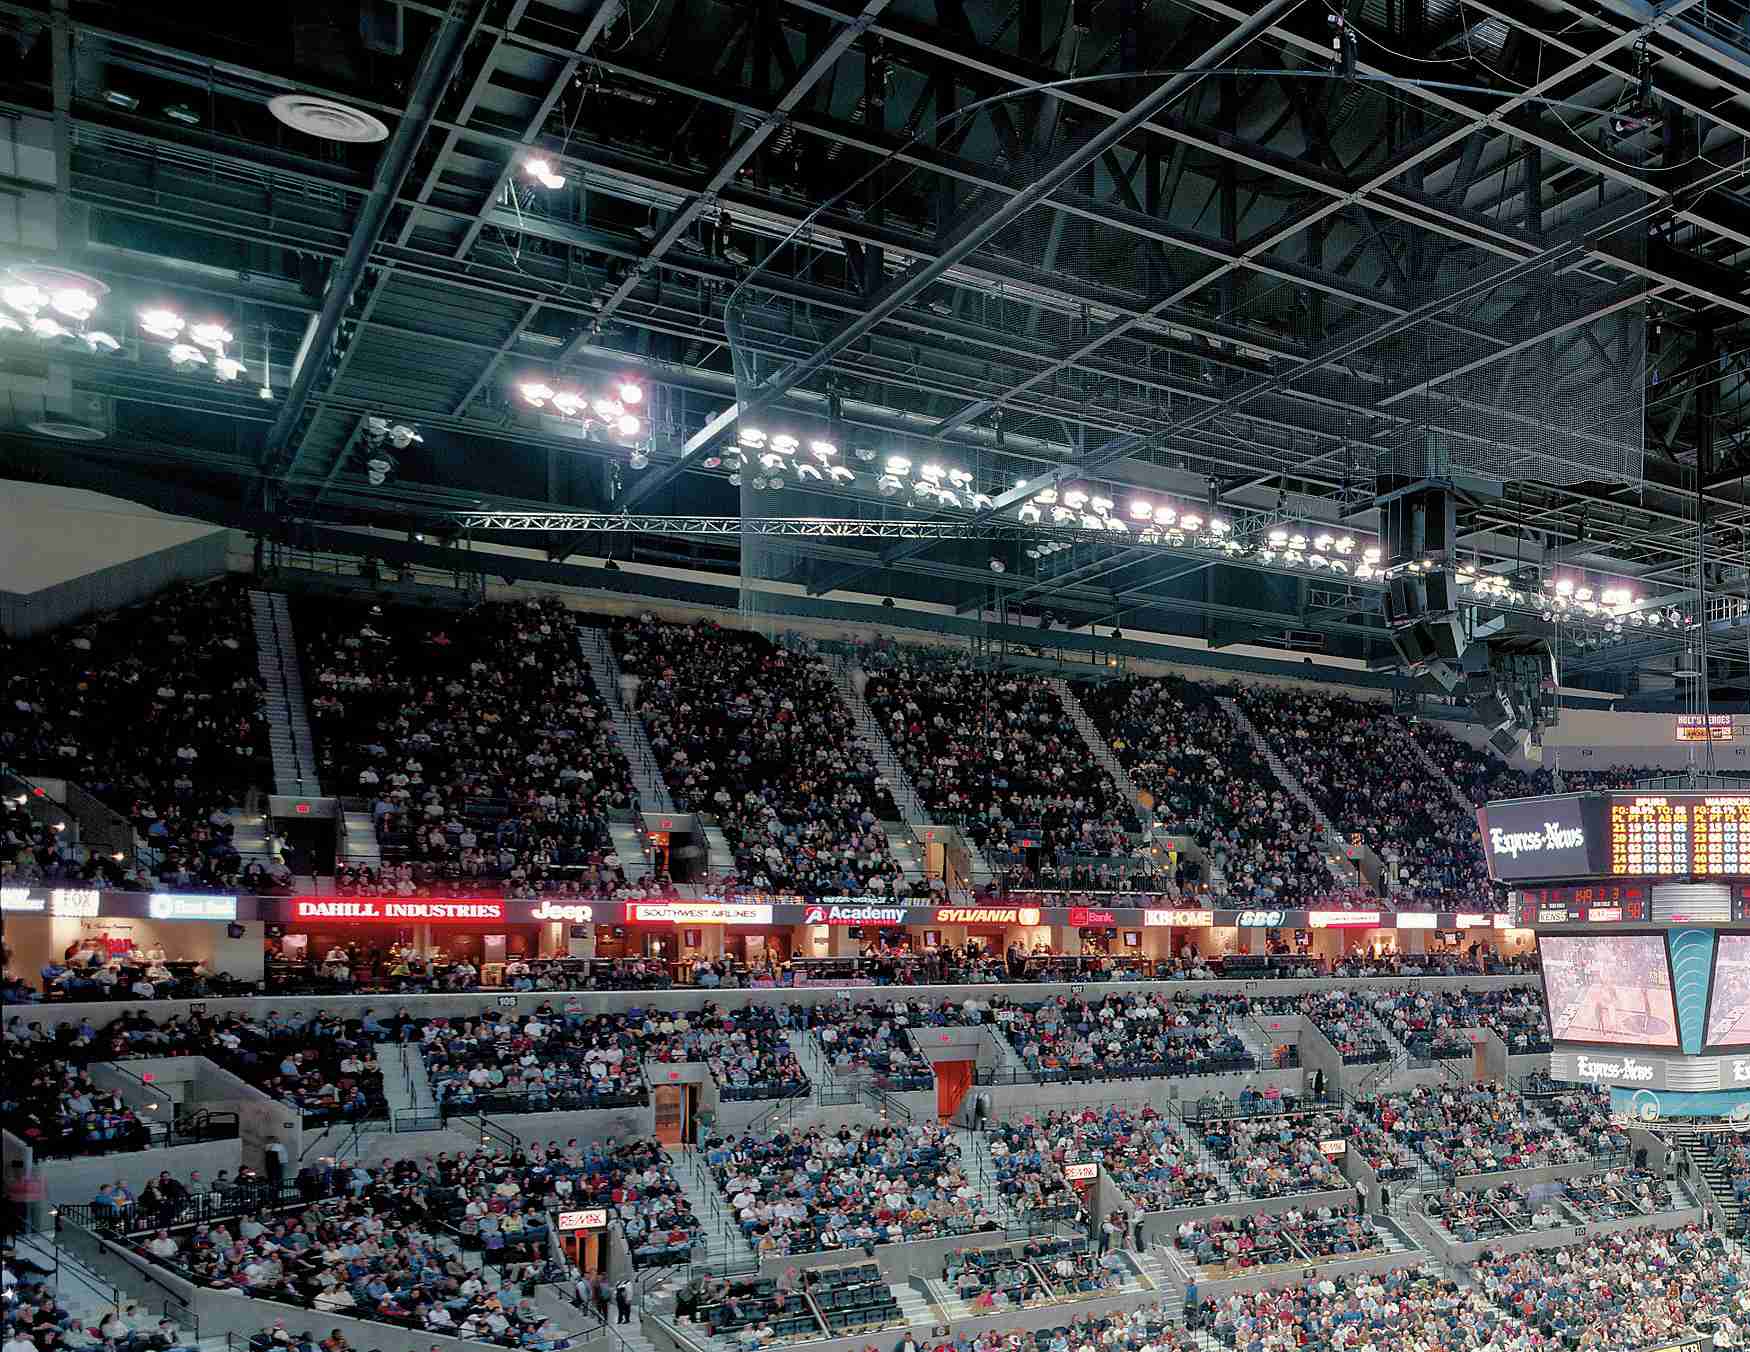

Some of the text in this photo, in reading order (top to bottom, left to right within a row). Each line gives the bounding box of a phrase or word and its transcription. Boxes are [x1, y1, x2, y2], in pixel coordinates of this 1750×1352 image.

[1613, 823, 1626, 832] 21
[1643, 823, 1657, 832] 02
[1673, 823, 1687, 832] 05
[1489, 822, 1585, 858] Express-News
[1613, 833, 1626, 843] 20
[1643, 833, 1657, 843] 00
[1673, 833, 1687, 843] 01
[1724, 833, 1738, 843] 02
[1643, 844, 1657, 853] 02
[1673, 844, 1687, 853] 01
[1724, 844, 1738, 853] 01
[1643, 854, 1657, 863] 02
[1673, 854, 1687, 863] 02
[1724, 854, 1738, 863] 00
[1613, 864, 1626, 873] 07
[1643, 864, 1657, 873] 00
[1673, 864, 1687, 873] 02
[1709, 864, 1722, 873] 00
[1724, 864, 1738, 873] 00
[299, 902, 501, 918] DAHILL INDUSTRIES
[532, 901, 592, 922] Jeep
[643, 908, 757, 918] SOUTHWEST AIRLINES
[829, 905, 904, 922] Academy
[937, 909, 1017, 922] SYLVANIA
[499, 997, 516, 1006] 105
